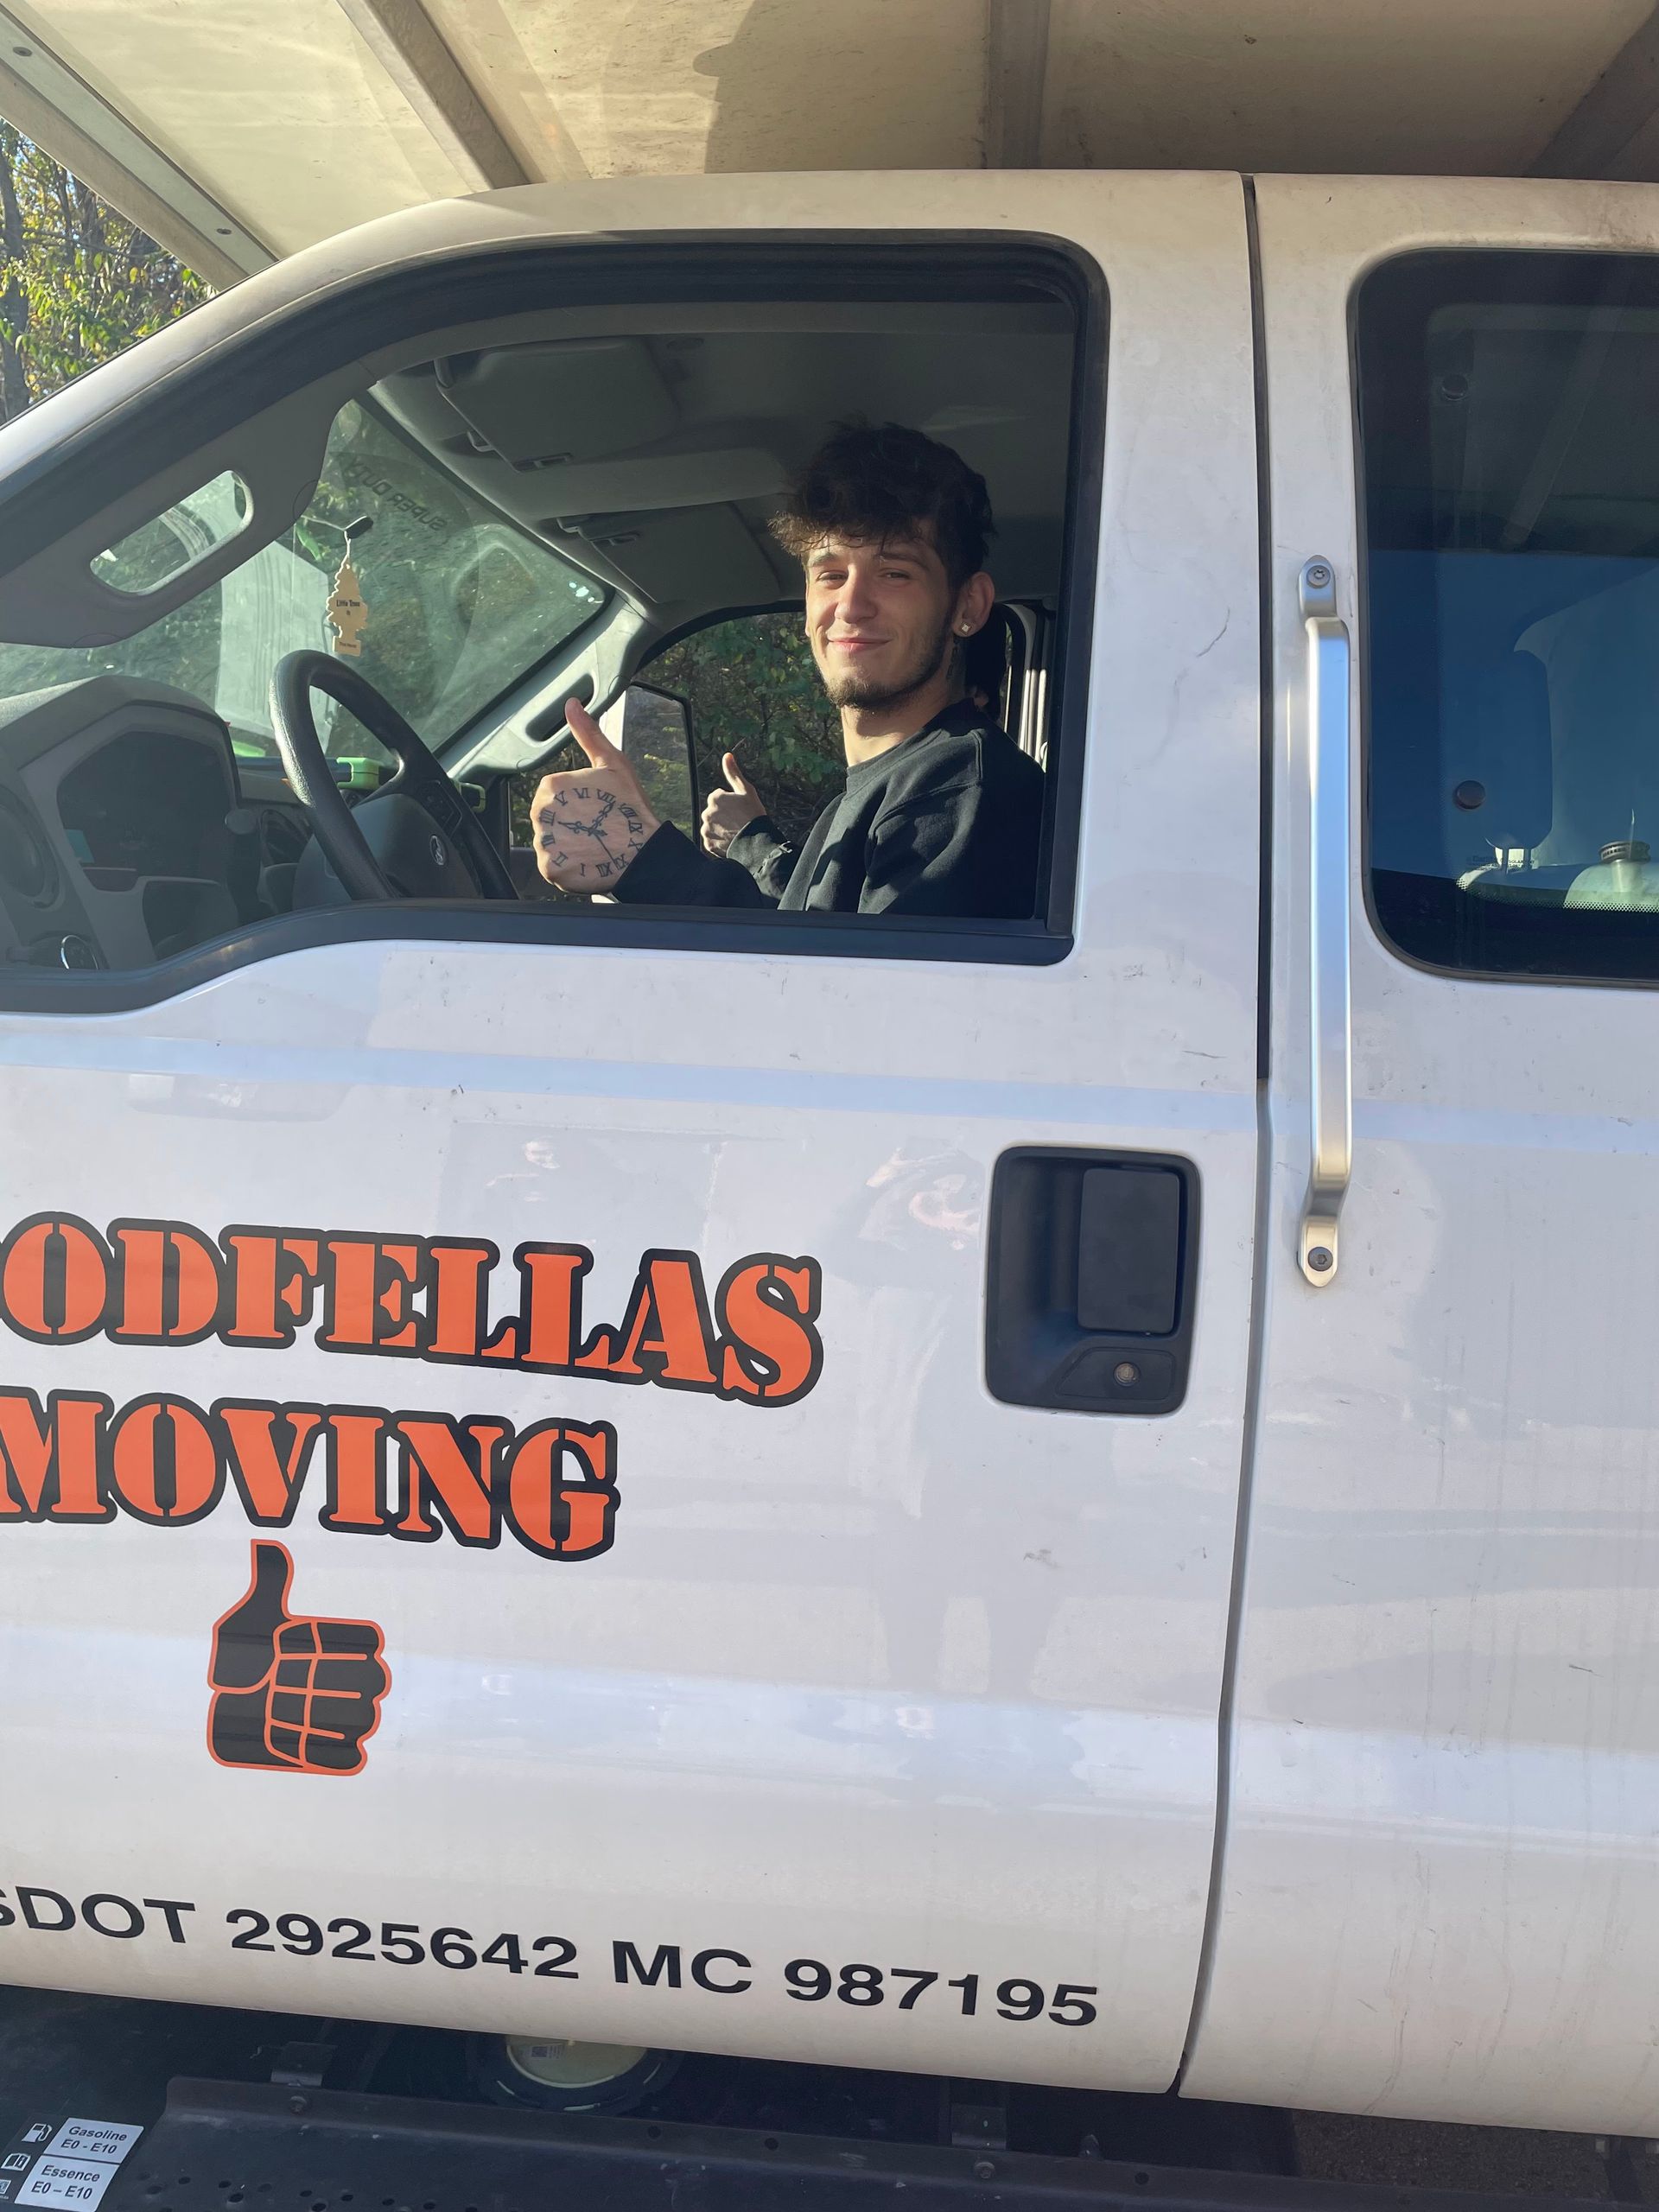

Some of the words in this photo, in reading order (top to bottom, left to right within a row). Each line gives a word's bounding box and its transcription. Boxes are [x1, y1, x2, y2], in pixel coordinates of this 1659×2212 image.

[0, 1386, 620, 1562] MOVING
[0, 1886, 195, 1944] DOT
[226, 1910, 578, 1980] 2925642
[613, 1941, 752, 1994] MC
[785, 1960, 1097, 2026] 987195
[68, 2126, 128, 2142] Gasoline
[60, 2139, 80, 2150] E0
[90, 2142, 118, 2155] E10
[41, 2164, 101, 2183] Essence
[31, 2181, 52, 2194] E0
[65, 2186, 93, 2200] E10
